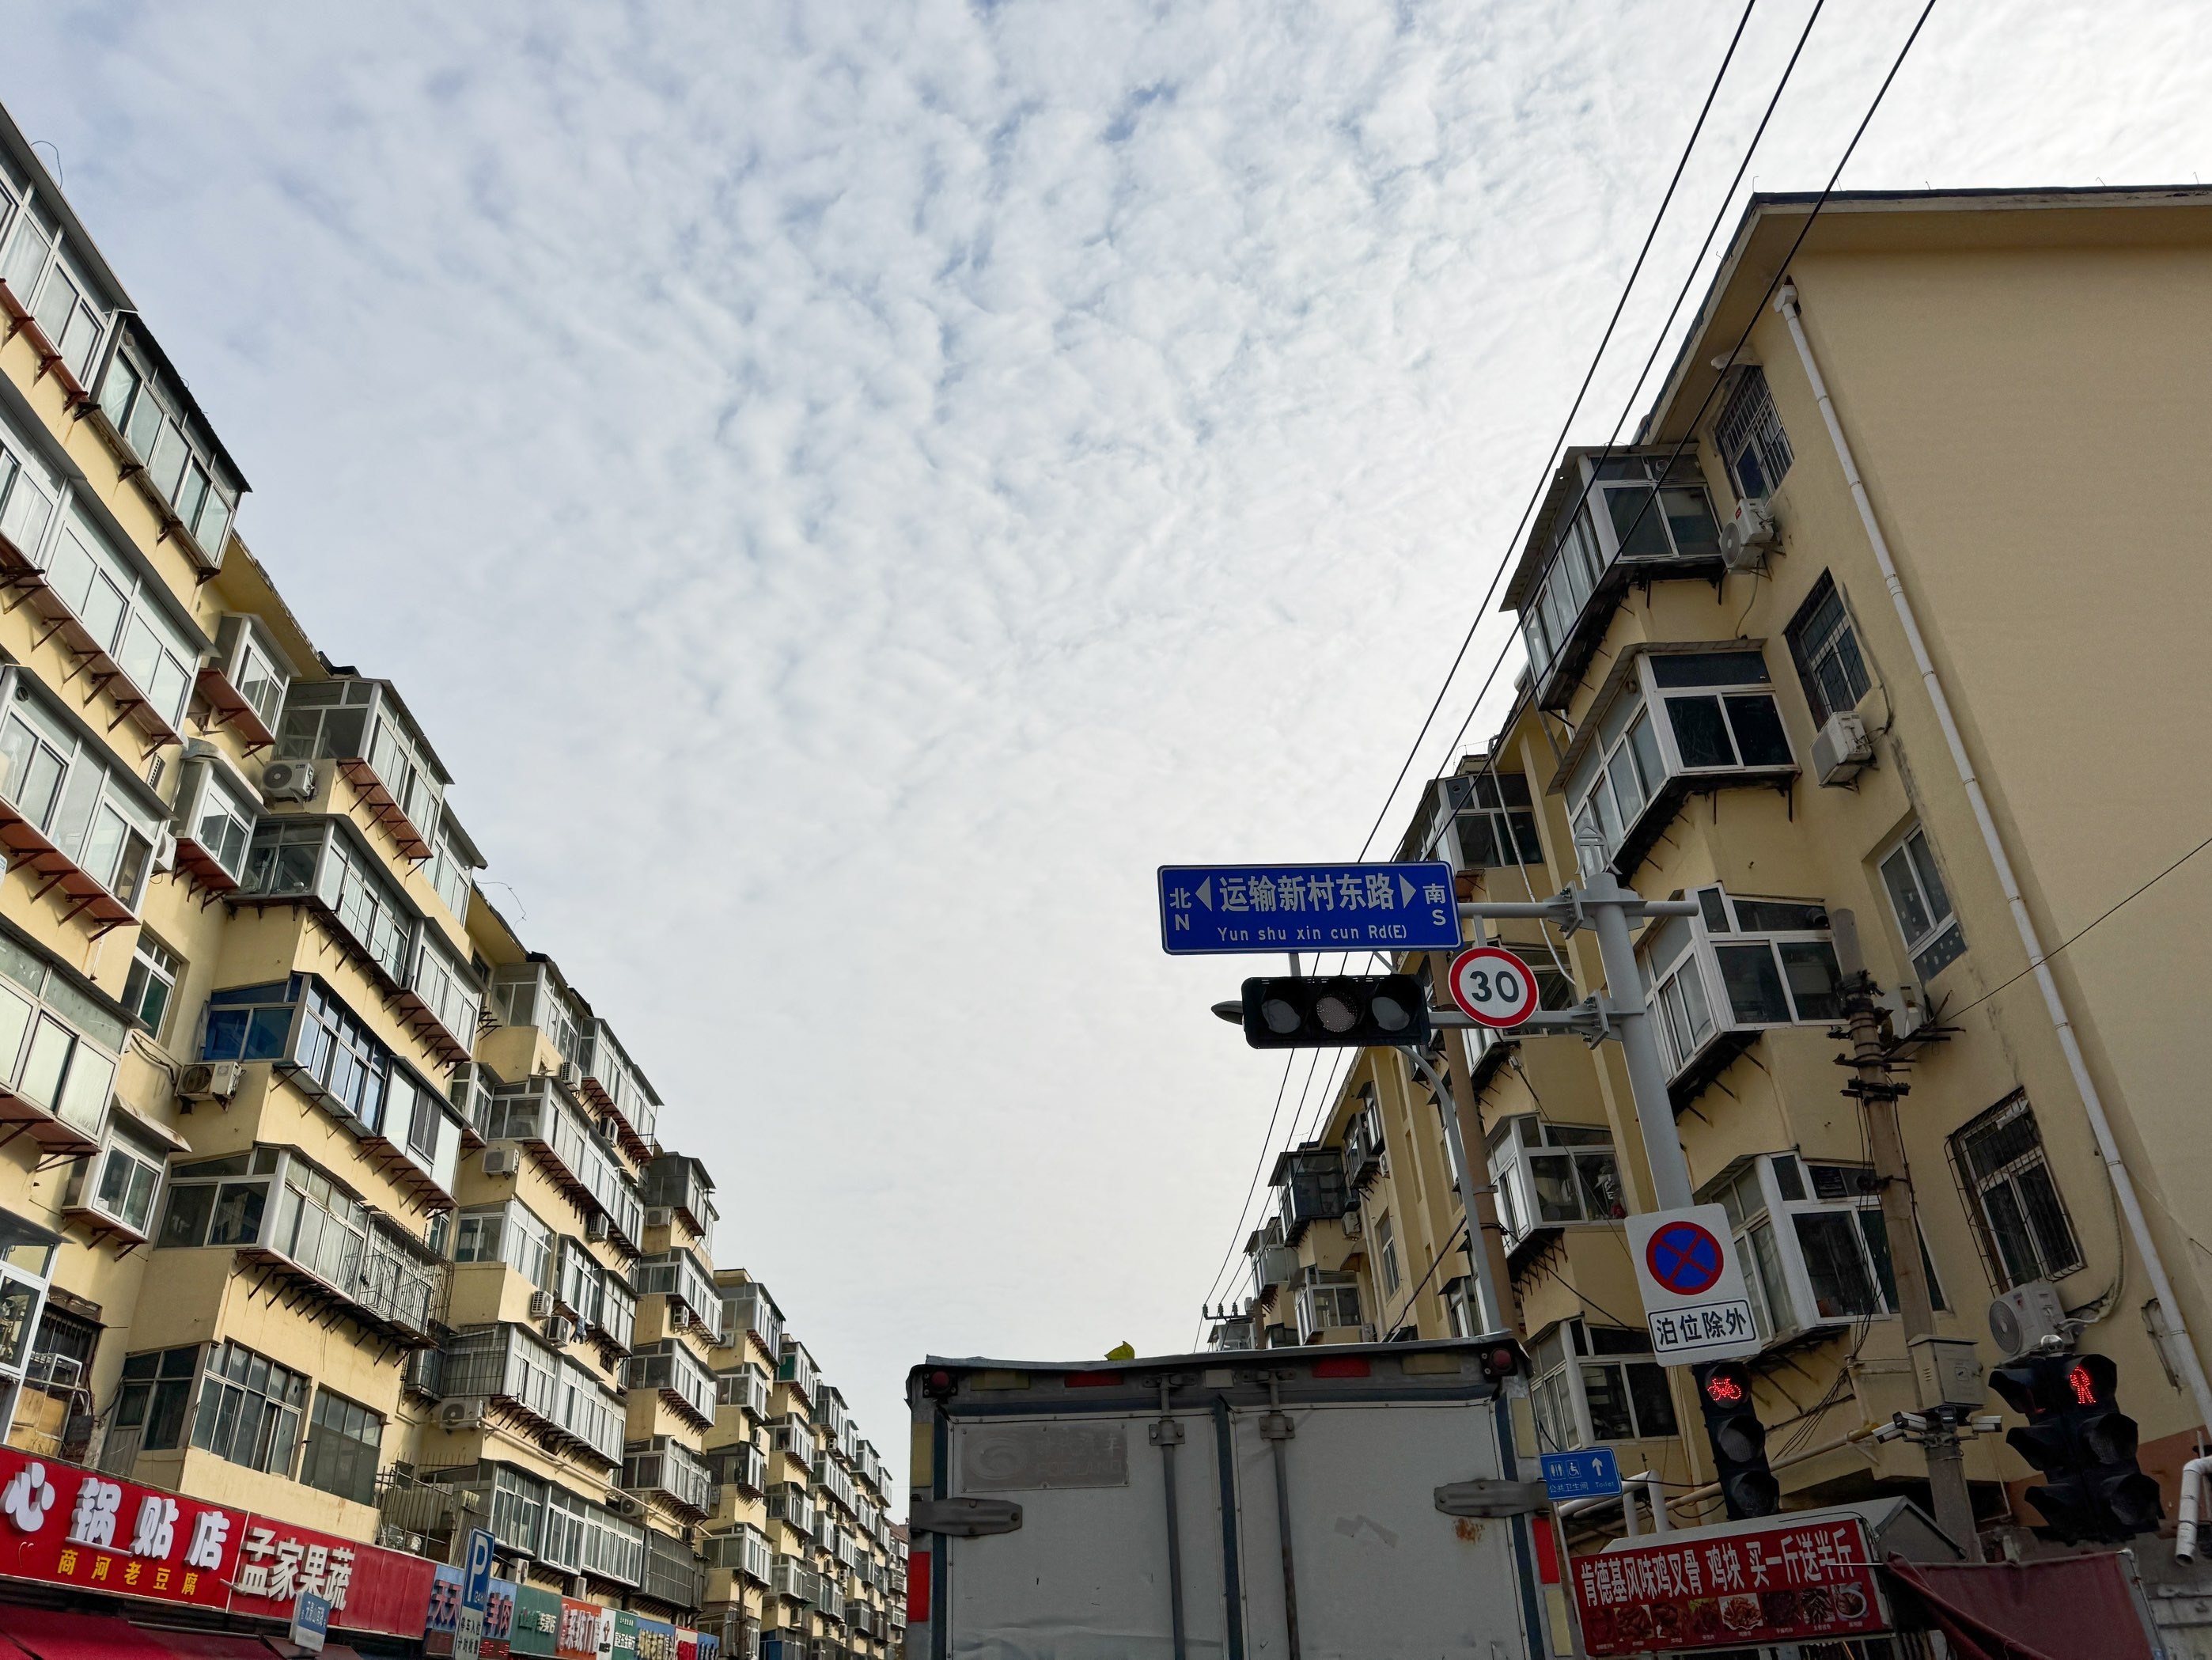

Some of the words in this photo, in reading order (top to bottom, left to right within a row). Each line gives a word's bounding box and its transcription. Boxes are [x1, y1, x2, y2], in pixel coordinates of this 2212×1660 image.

[1169, 888, 1192, 908] 北
[1219, 873, 1395, 912] 运输新村东路
[1422, 883, 1445, 904] 南
[1174, 914, 1190, 930] N
[1217, 927, 1249, 942] Yun
[1259, 925, 1286, 941] shu
[1297, 925, 1322, 940] xin
[1331, 925, 1359, 940] cun
[1368, 924, 1408, 940] Rd(E)
[1432, 909, 1446, 926] S
[1469, 970, 1521, 1004] 30
[1657, 1309, 1748, 1346] 泊位除外
[1548, 1481, 1589, 1493] 公共卫生间
[1, 1462, 231, 1571] 心锅贴店
[57, 1548, 200, 1596] 商河老豆腐
[239, 1526, 355, 1611] 孟家果蔬
[468, 1535, 490, 1602] P
[1581, 1548, 1703, 1608] 肯德基风味鸡叉骨
[1705, 1541, 1746, 1593] 鸡块
[1747, 1527, 1855, 1588] 买一斤送半斤
